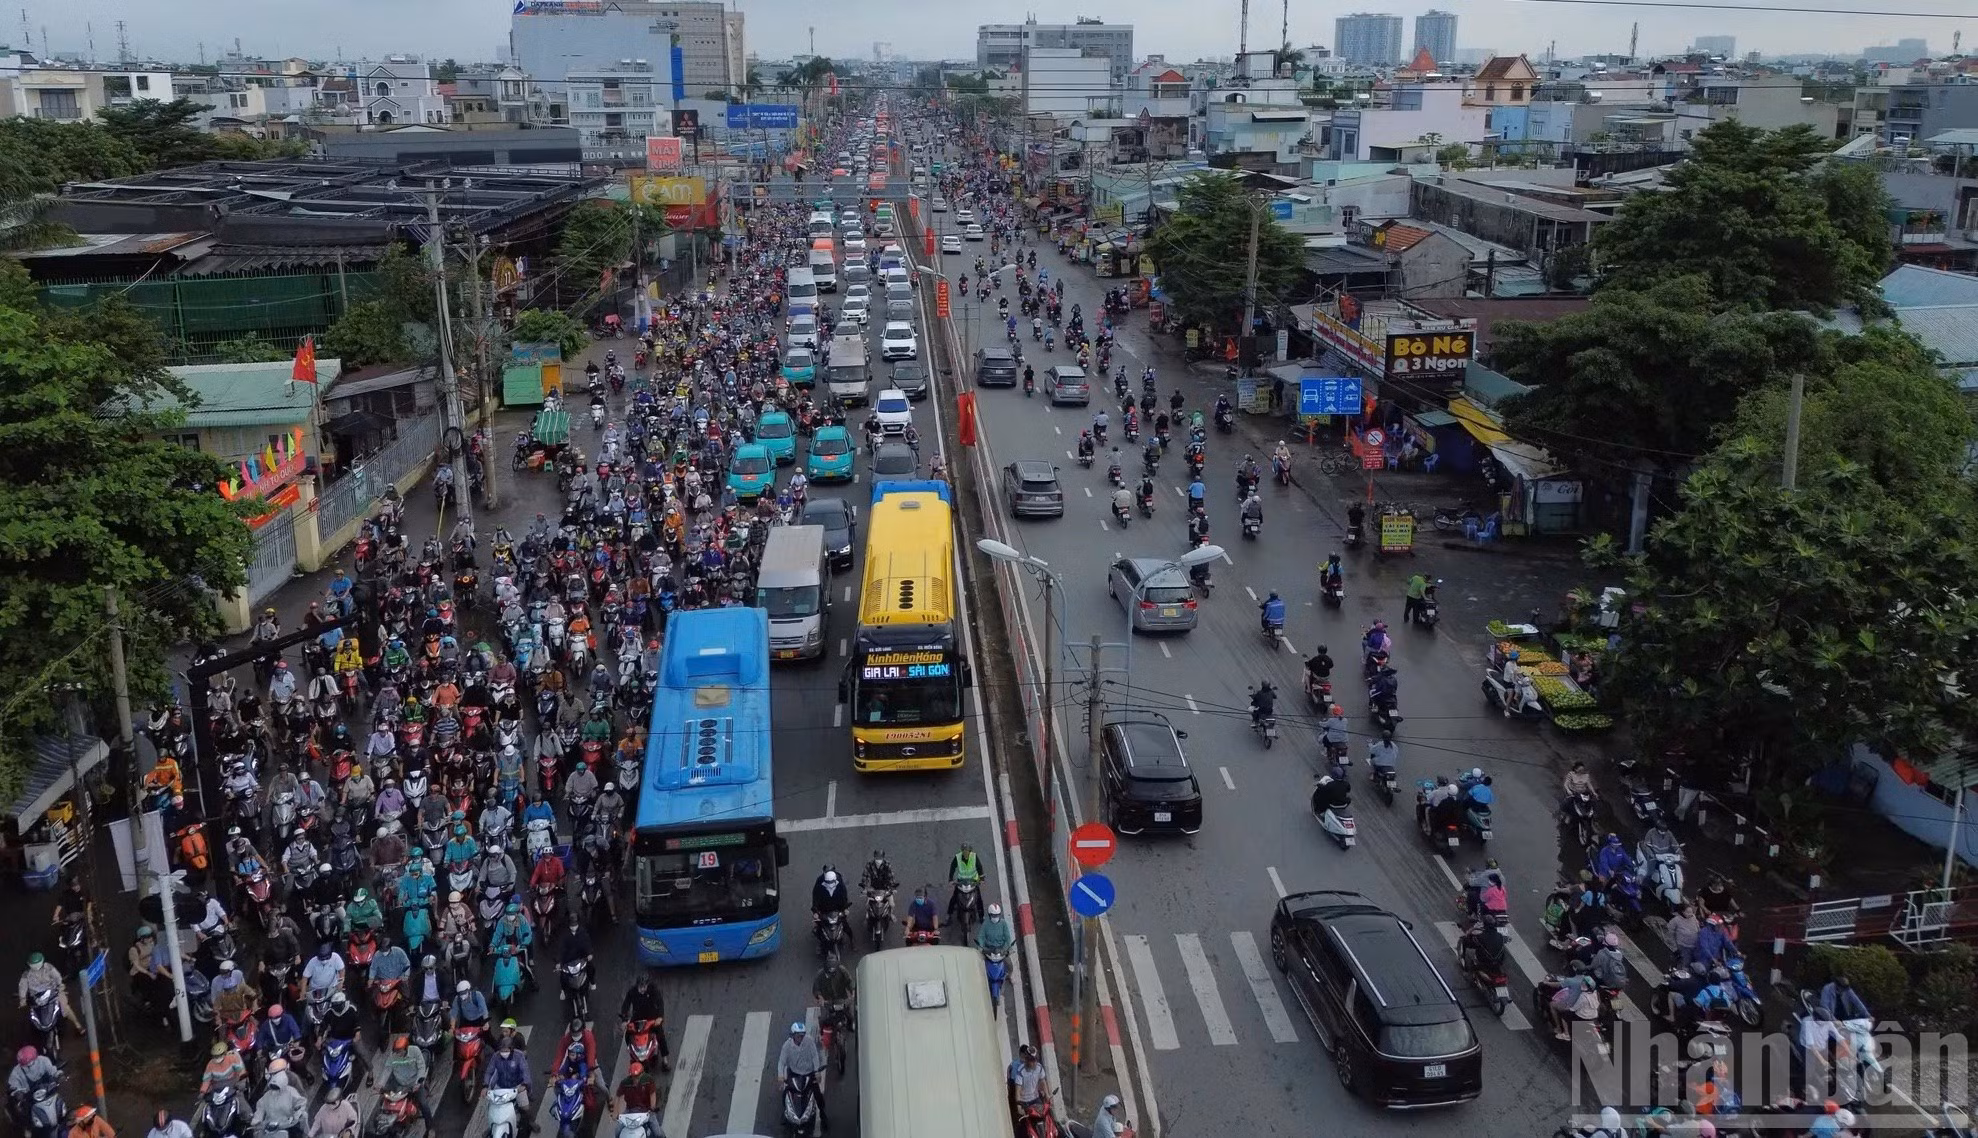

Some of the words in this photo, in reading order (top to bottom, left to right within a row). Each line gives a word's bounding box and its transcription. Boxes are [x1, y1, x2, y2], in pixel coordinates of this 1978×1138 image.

[1394, 337, 1427, 356] Bò
[1433, 336, 1467, 354] Né
[1412, 357, 1421, 370] 3
[1425, 356, 1467, 371] Ngon
[864, 667, 881, 678] GIA
[884, 666, 899, 678] LAI
[700, 853, 717, 866] 19
